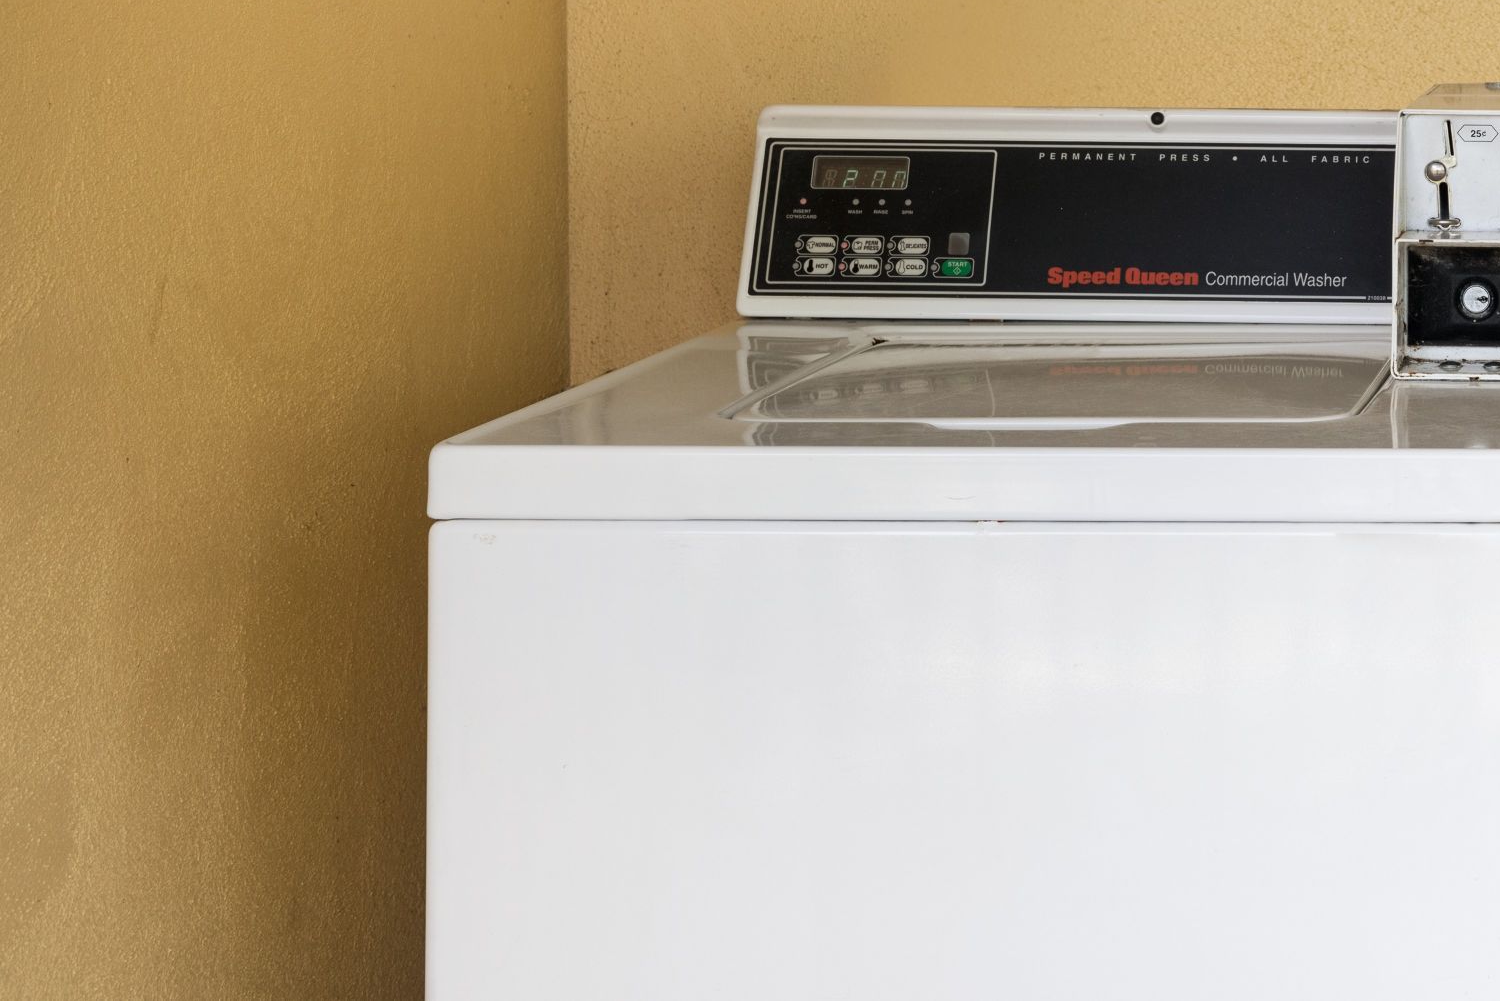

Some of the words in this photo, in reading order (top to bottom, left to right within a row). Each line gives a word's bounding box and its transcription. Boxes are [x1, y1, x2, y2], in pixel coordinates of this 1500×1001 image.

[1470, 129, 1487, 138] 25¢
[1039, 152, 1138, 161] PERMANENT
[1158, 153, 1211, 162] PRESS
[1259, 154, 1289, 163] ALL
[1310, 155, 1371, 164] FABRIC
[1047, 267, 1121, 288] Speed
[1125, 267, 1199, 286] Queen
[1205, 270, 1289, 287] Commercial
[1293, 272, 1347, 288] Washer
